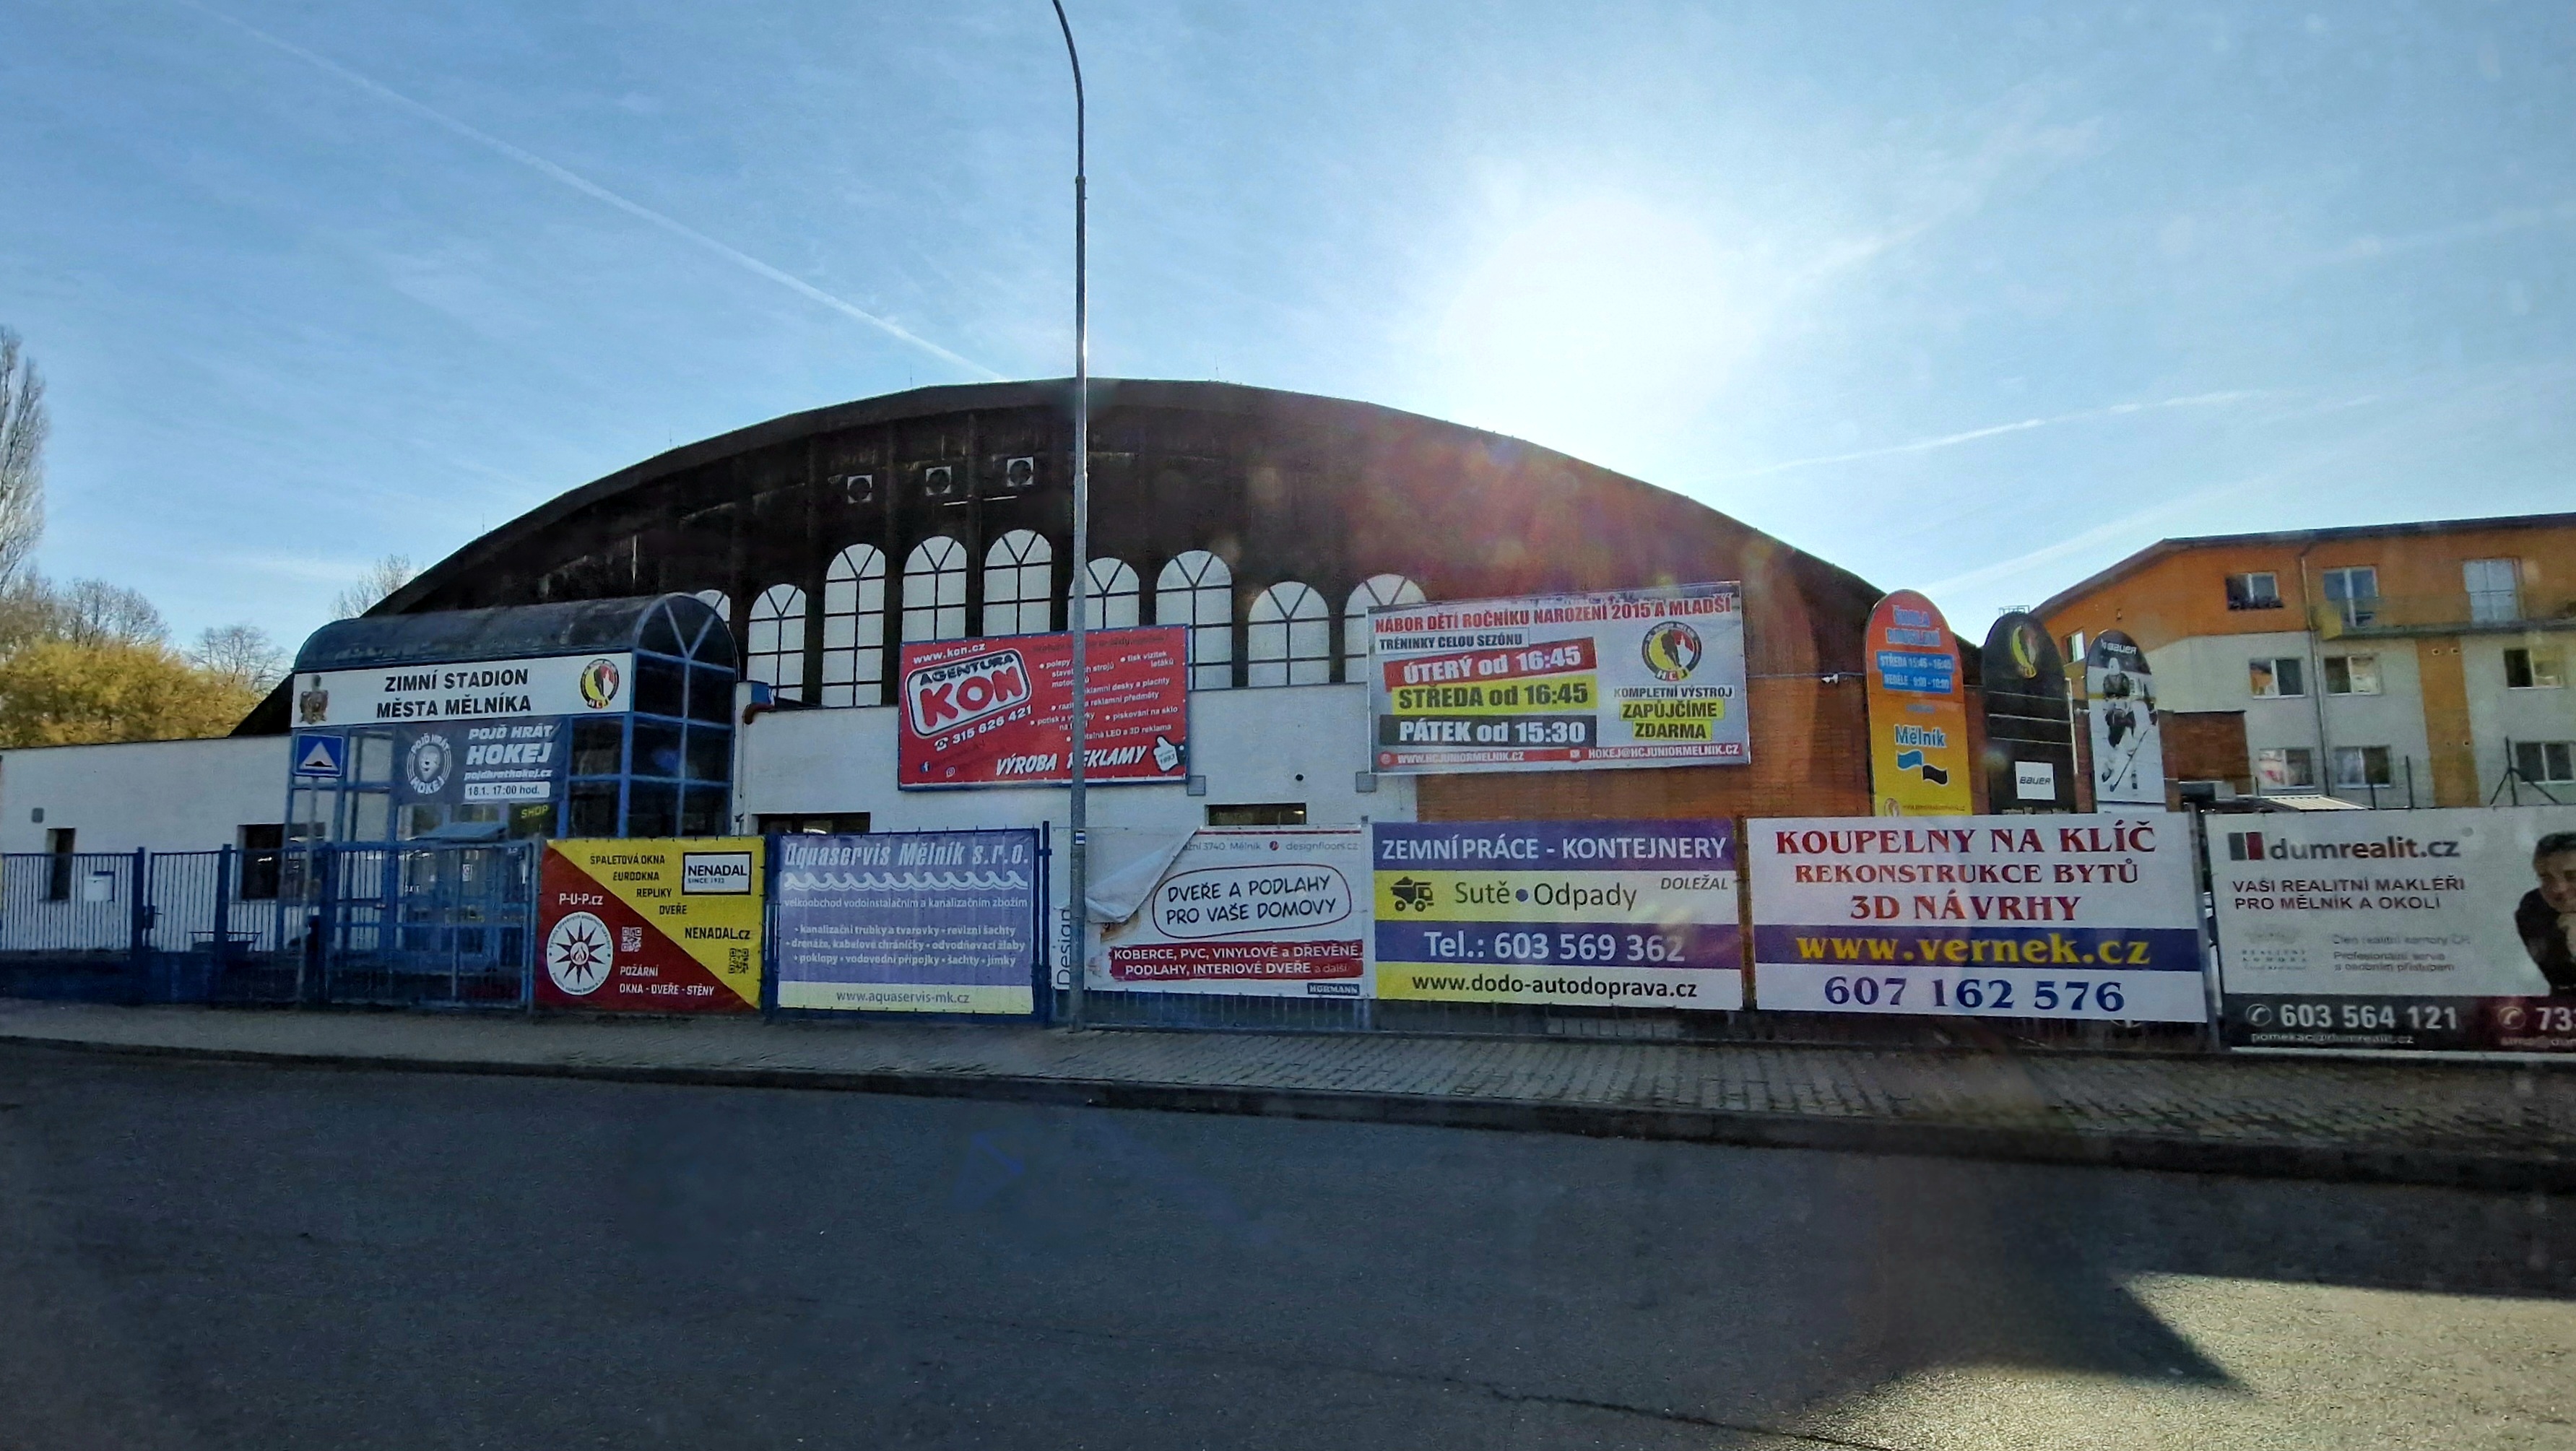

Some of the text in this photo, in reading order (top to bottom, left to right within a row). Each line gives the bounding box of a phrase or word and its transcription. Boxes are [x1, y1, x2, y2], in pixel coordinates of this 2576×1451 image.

[1375, 594, 1732, 633] NÁBOR DĚTÍ ROČNÍKU NAROZENÍ 2015 A MLADŠÍ
[1380, 632, 1523, 650] TRÉNINKY CELOU SEZÓNU
[913, 642, 986, 664] www.kon.cz
[1127, 651, 1167, 662] tisk vizitek
[920, 654, 1015, 686] AGENTURA
[1046, 659, 1071, 669] polepy
[1403, 645, 1581, 684] ÚTERÝ od 16:45
[384, 668, 529, 693] ZIMNÍ STADION
[1112, 677, 1170, 692] desky plachty
[920, 666, 1023, 728] KON
[1399, 681, 1588, 709] STŘEDA od 16:45
[1613, 685, 1732, 698] KOMPLETNÍ VÝSTROJ
[376, 692, 532, 719] MĚSTA MĚLNÍKA
[1091, 696, 1122, 706] reklamní
[1162, 706, 1179, 714] sklo
[952, 704, 1033, 745] 315 626 421
[1037, 715, 1059, 727] potisk
[468, 723, 554, 740] POJĎ HRÁT
[1106, 728, 1122, 737] LED
[1142, 723, 1172, 733] reklama
[1399, 717, 1585, 743] PÁTEK od 15:30
[1634, 722, 1707, 739] ZDARMA
[1895, 725, 1946, 747] Mělník
[466, 742, 554, 766] HOKEJ
[1397, 750, 1525, 764] WWW.HCJUNIORMELNIK.CZ
[1589, 744, 1740, 759] HOKEJ@HCJUNIORMELNIK.CZ
[996, 753, 1058, 776] VÝROBA
[409, 775, 446, 794] HOKEJ
[2019, 776, 2051, 785] BAUER
[468, 785, 540, 797] 18.1. 17:00 hod.
[521, 805, 550, 818] SHOP
[1775, 820, 2156, 854] KOUPELNY NA KLÍČ
[1203, 841, 1226, 851] 3740
[1285, 841, 1358, 852] designfloors.cz
[1382, 833, 1727, 859] ZEMNÍ PRÁCE KONTEJNERY
[2270, 835, 2460, 860] dumrealit.cz
[641, 854, 665, 865] OKNA
[784, 841, 1028, 870] Aquaservis Mělník s.r.o.
[612, 871, 659, 881] EUROOKNA
[688, 865, 747, 877] NENADAL
[1795, 858, 2139, 883] REKONSTRUKCE BYTŮ
[1168, 875, 1330, 904] DVEŘE A PODLAHY
[1661, 874, 1728, 891] DOLEŽAL
[2232, 875, 2465, 893] VAŠI REALITNÍ MAKLÉŘI
[559, 893, 604, 906] P-U-P.cz
[636, 888, 672, 898] REPLIKY
[1455, 881, 1636, 911] Sutě Odpady
[659, 903, 688, 915] DVEŘE
[784, 896, 1028, 908] velkoobchod vodoinstalačním a kanalizačním zbožím
[1850, 888, 2081, 921] 3D NÁVRHY
[2234, 895, 2440, 910] PRO MĚLNÍK A OKOLÍ
[1166, 898, 1337, 925] PRO VAŠE DOMOVY
[685, 927, 750, 940] NENADAL.cz
[800, 924, 1017, 937] kanalizační trubky tvarovky revizní šachty
[997, 940, 1025, 952] žlaby
[1114, 944, 1289, 961] KOBERCE, PVC, VINYLOVÉ a
[1423, 930, 1686, 962] Tel.: 603 569 362
[1795, 932, 2151, 965] www.vernek.cz
[799, 953, 838, 966] poklopy
[845, 953, 896, 964] vodovodní
[947, 954, 981, 966] šachty
[986, 955, 1017, 967] jímky
[1125, 960, 1311, 976] PODLAHY, INTERIOVÉ DVEŘE
[620, 964, 659, 977] POŽÁRNÍ
[620, 982, 715, 997] OKNA DVEŘE STĚNY
[1412, 973, 1698, 998] www.dodo-autodoprava.cz
[1824, 976, 2125, 1012] 607 162 576
[836, 991, 971, 1005] www.aquaservis-mk.cz
[2280, 1004, 2457, 1030] 603 564 121
